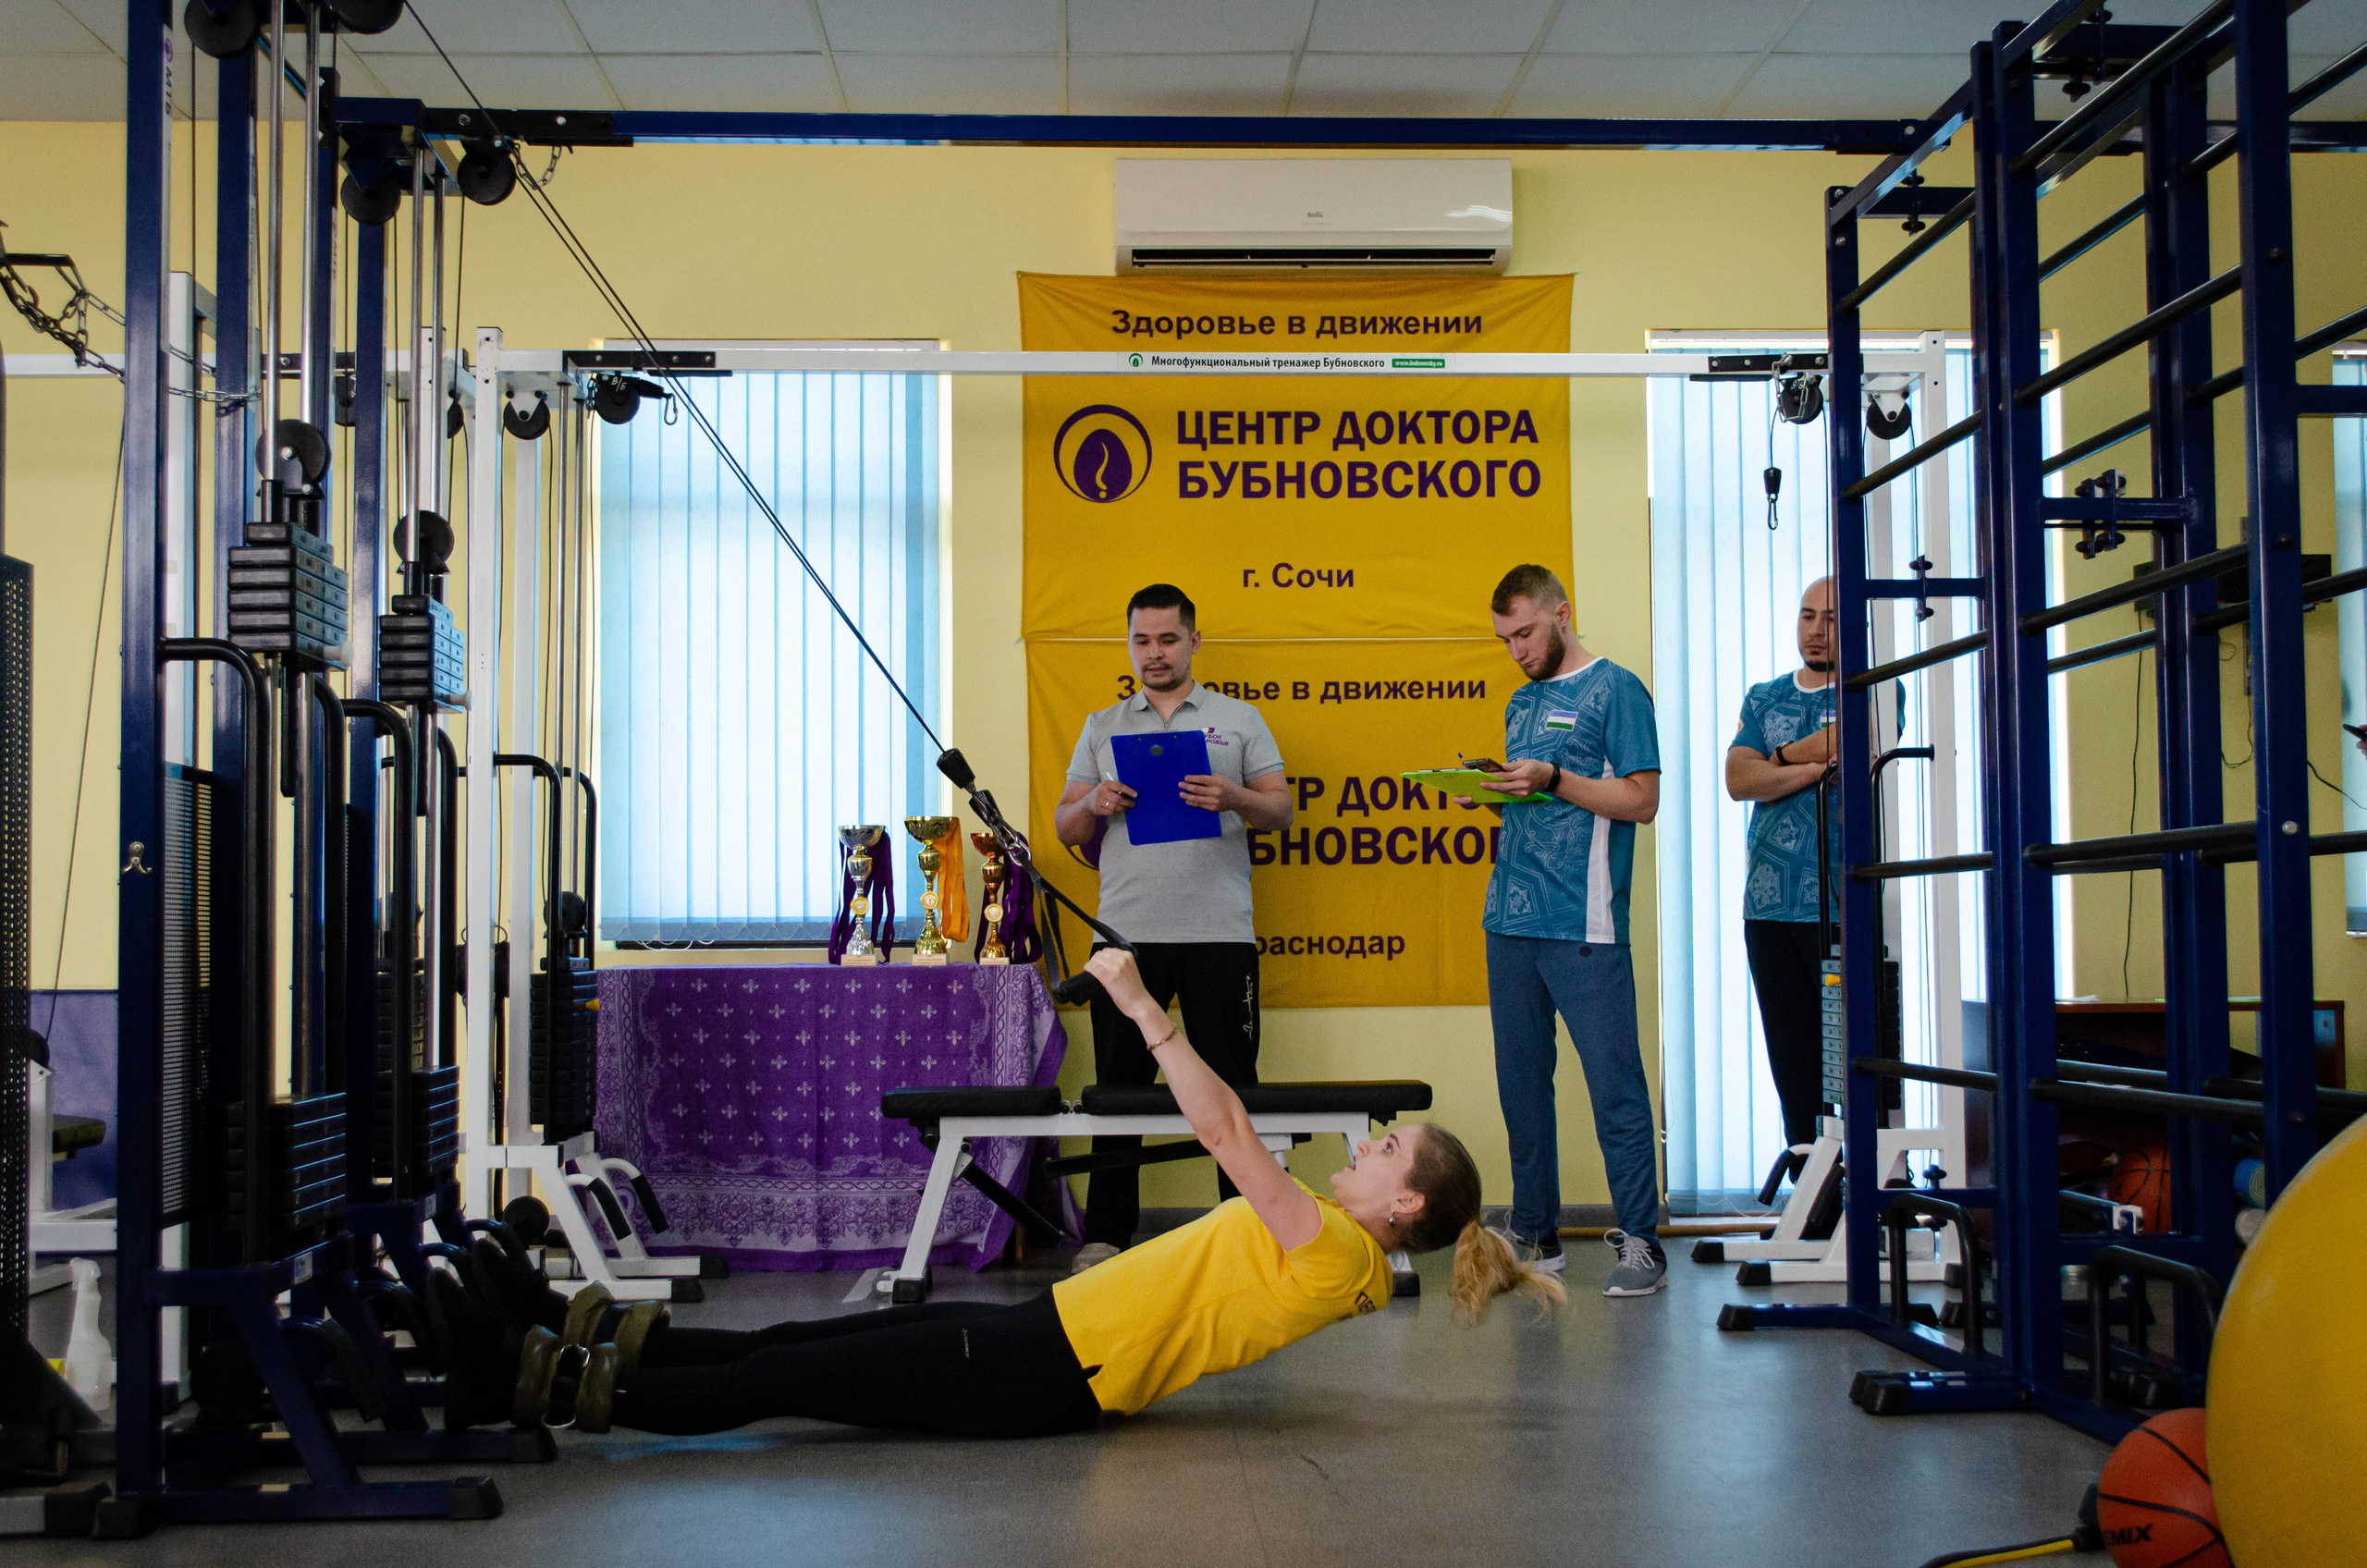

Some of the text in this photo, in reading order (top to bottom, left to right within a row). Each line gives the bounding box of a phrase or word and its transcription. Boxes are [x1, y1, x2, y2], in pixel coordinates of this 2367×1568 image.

[1112, 310, 1481, 339] Здоровье в движении
[1151, 356, 1385, 370] Многофункциональный тренажер Бубновского
[1178, 410, 1538, 451] ЦЕНТР ДОКТОРА
[1180, 459, 1539, 498] БУБНОВСКОГО
[1243, 563, 1353, 588] г. Сочи
[1293, 682, 1309, 699] в
[1320, 681, 1485, 704] движении
[1256, 935, 1405, 961] раснодар
